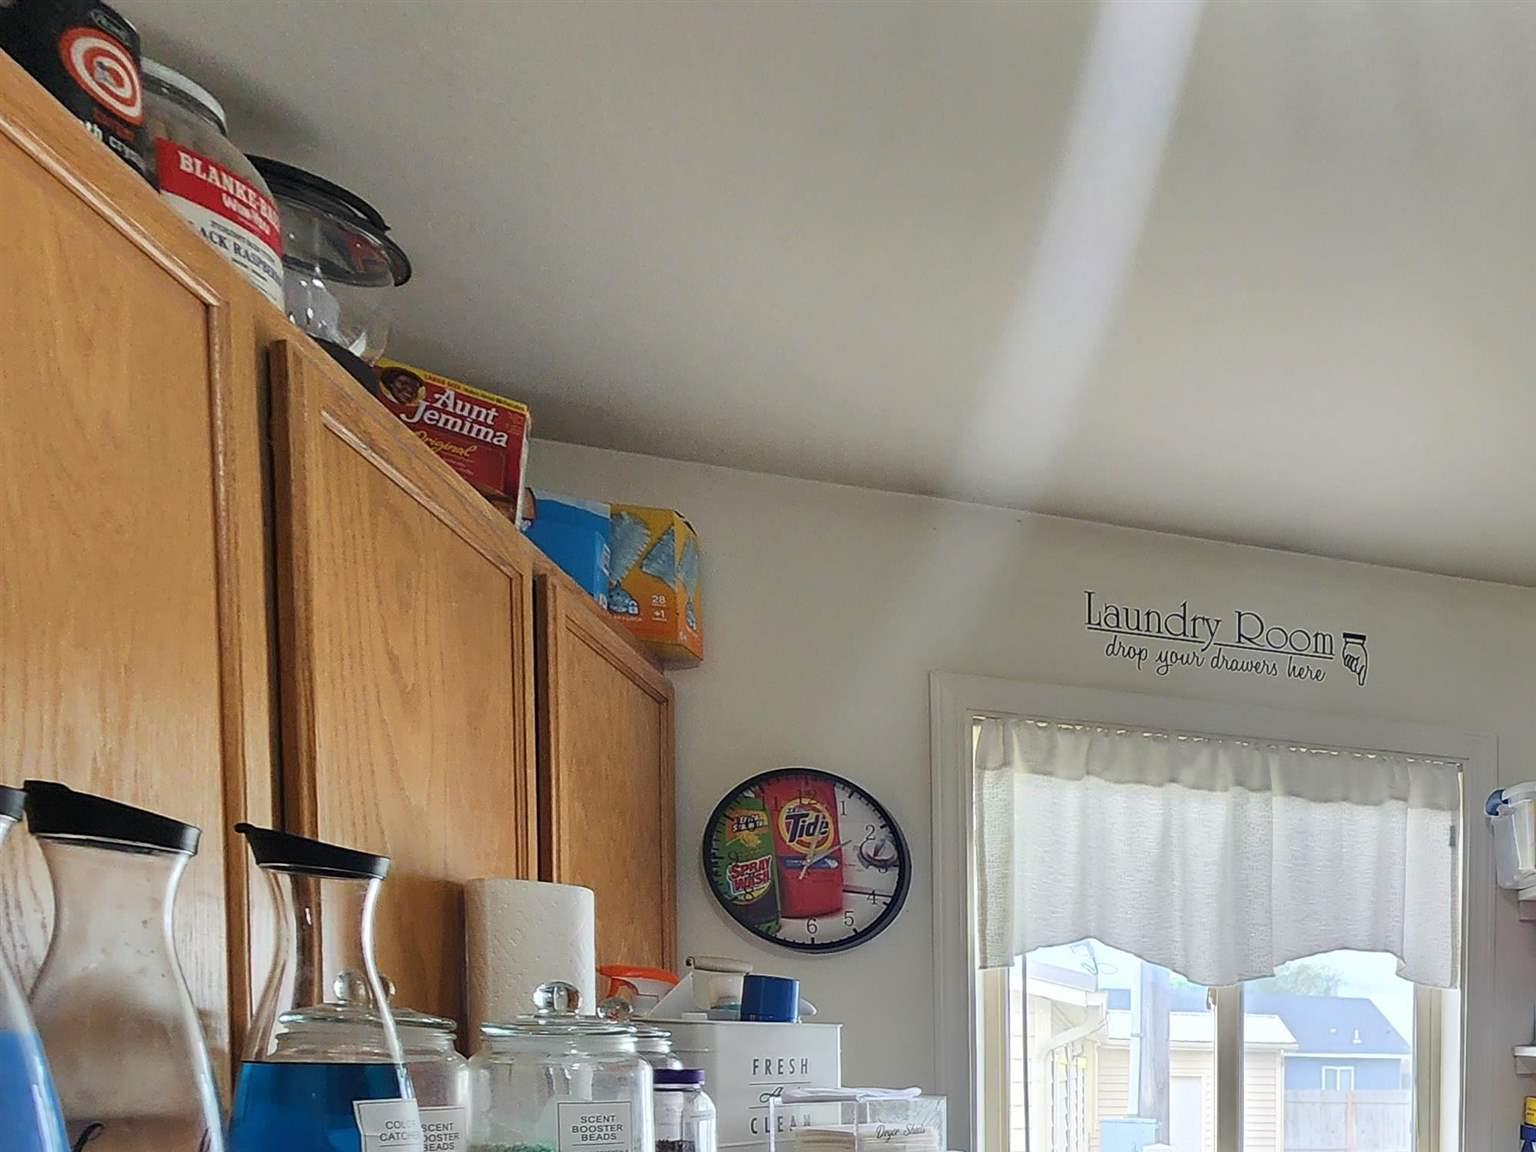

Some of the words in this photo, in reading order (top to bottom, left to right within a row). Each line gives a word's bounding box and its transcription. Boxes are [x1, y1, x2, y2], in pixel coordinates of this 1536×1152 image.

[434, 387, 499, 426] Aunt
[400, 400, 509, 448] Jemima
[1083, 590, 1223, 652] Laundry
[1234, 609, 1336, 656] Room
[1105, 634, 1149, 671] drop
[1154, 648, 1206, 677] your
[1210, 648, 1279, 678] drawers
[1286, 655, 1327, 682] here
[806, 918, 818, 935] 6
[843, 910, 856, 928] 5
[752, 1057, 810, 1077] FRESH
[571, 1123, 625, 1134] BOOSTER
[580, 1114, 617, 1125] SCENT
[580, 1132, 618, 1142] BEADS
